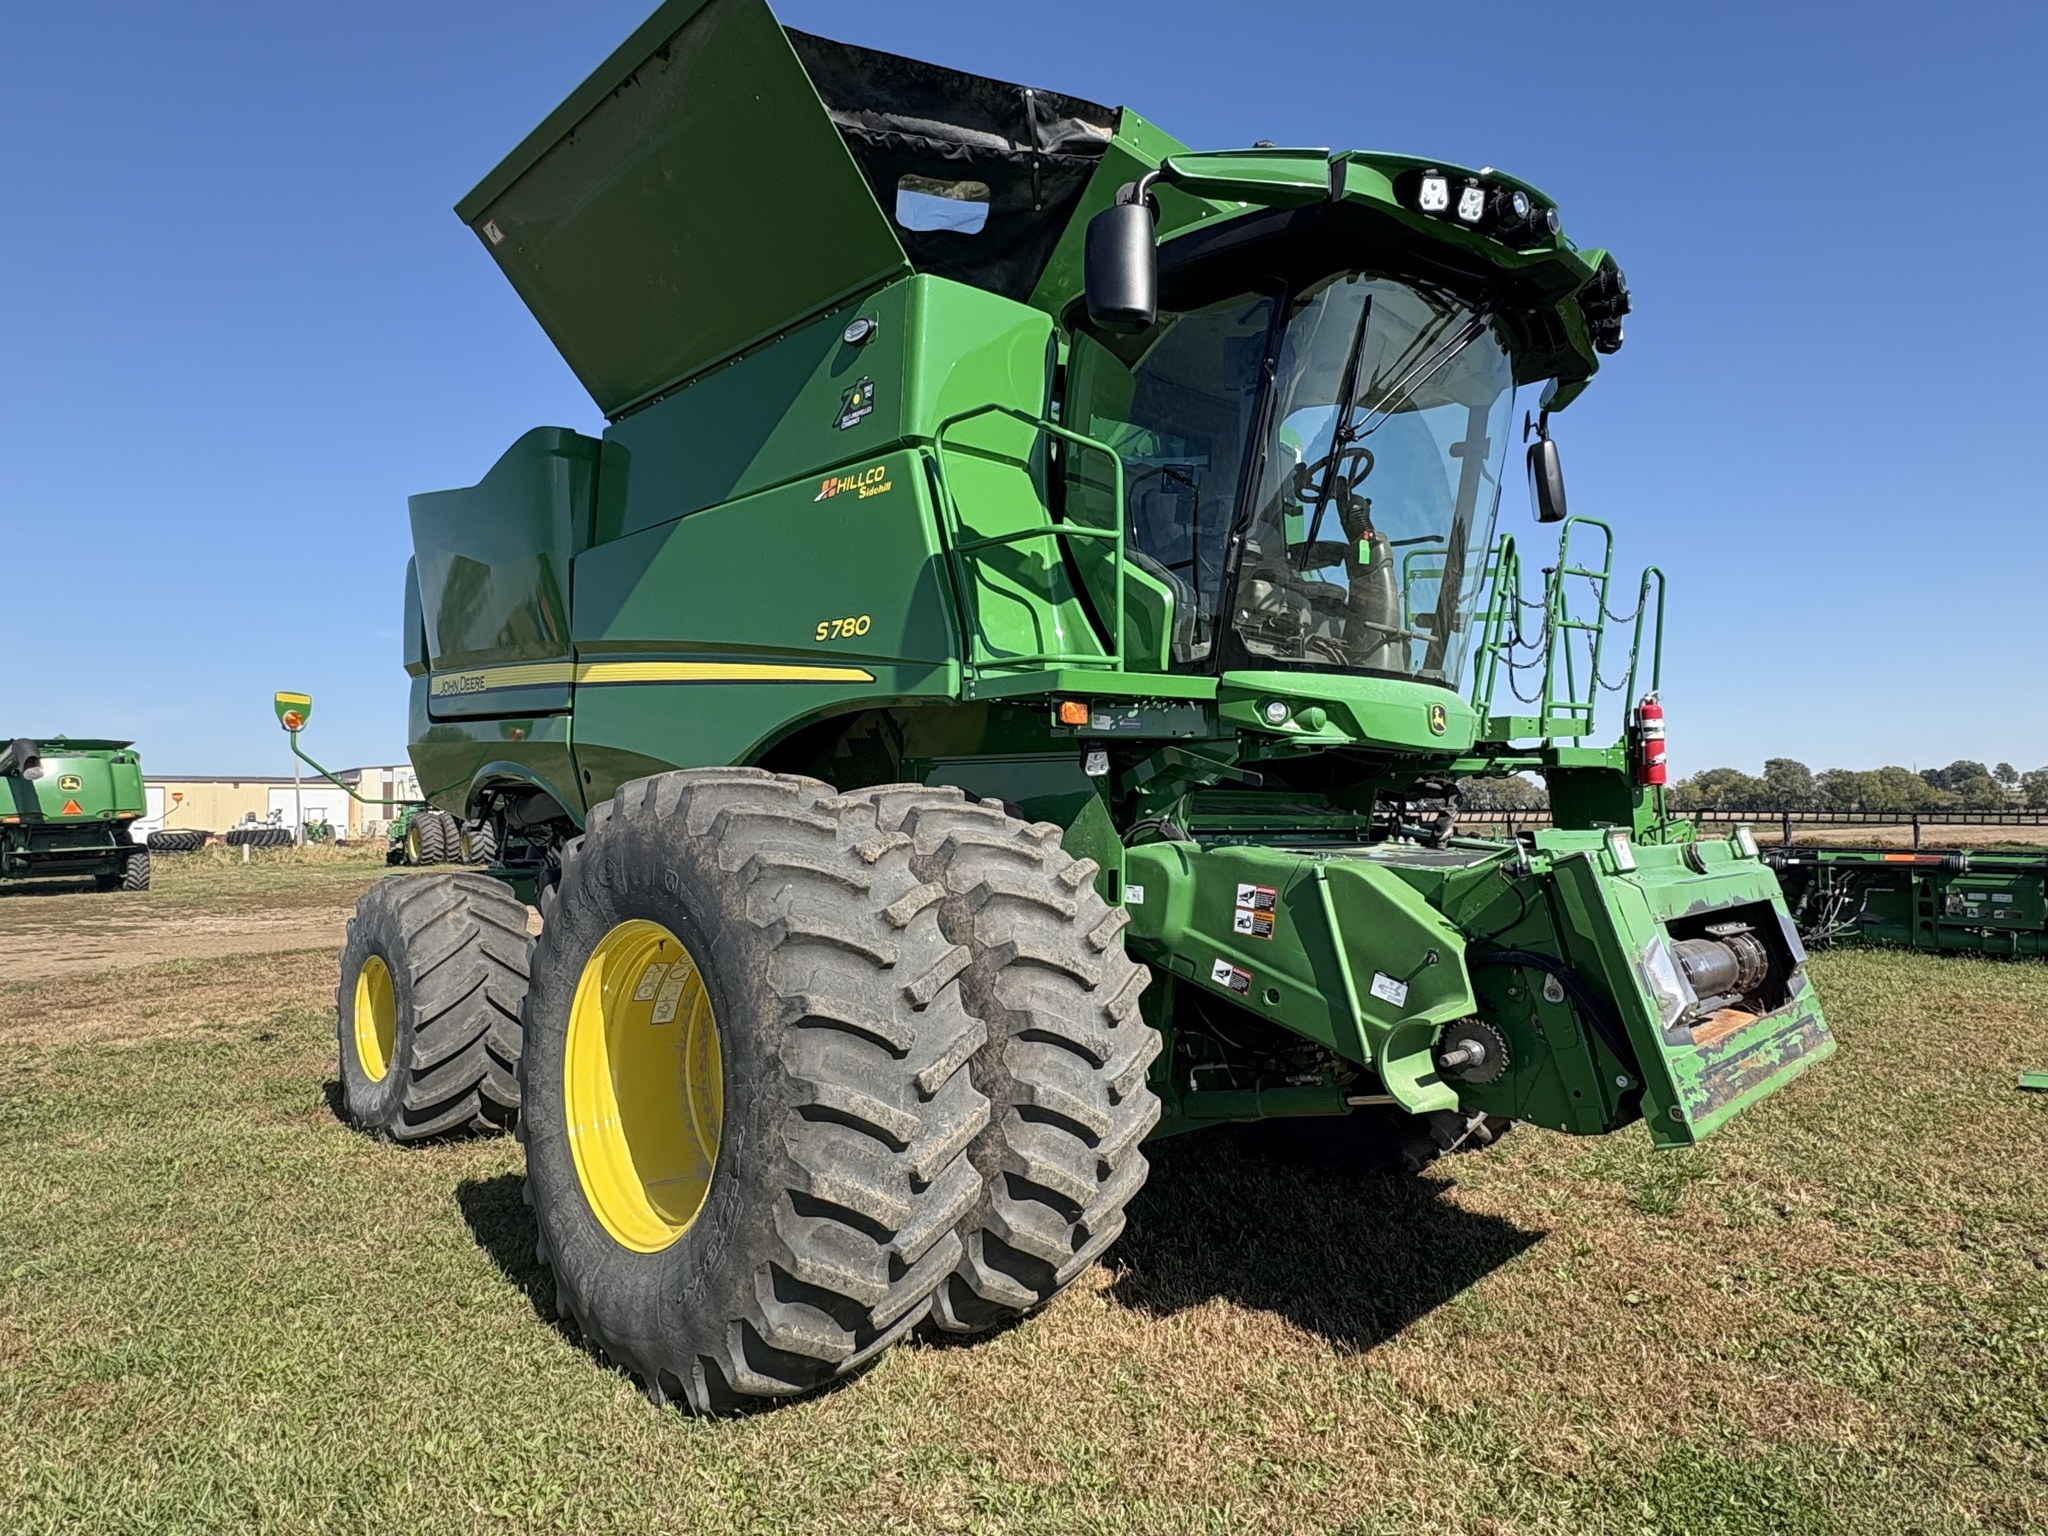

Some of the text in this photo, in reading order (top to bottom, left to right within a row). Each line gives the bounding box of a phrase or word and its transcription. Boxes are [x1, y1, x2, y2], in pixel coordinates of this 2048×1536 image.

[836, 466, 885, 494] HILLCO
[858, 481, 892, 499] Sidehill
[815, 615, 871, 641] S780
[440, 676, 485, 694] JOHN DEERE
